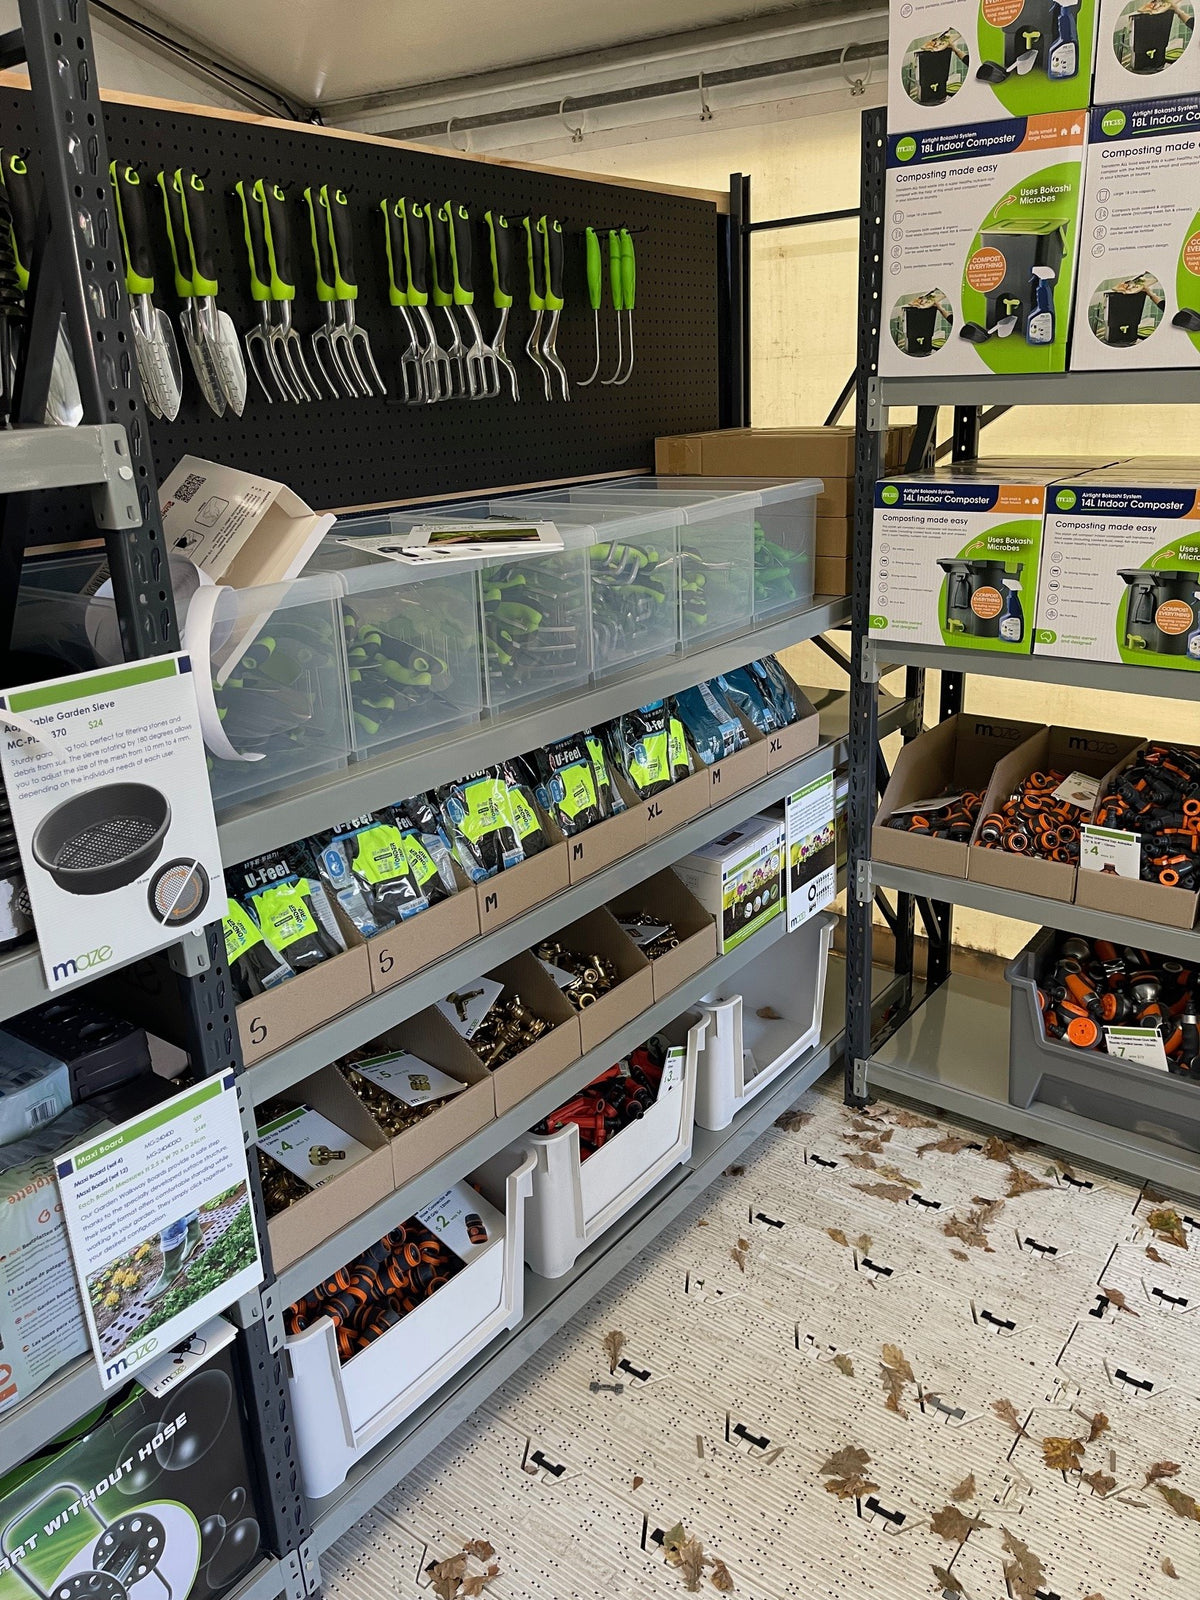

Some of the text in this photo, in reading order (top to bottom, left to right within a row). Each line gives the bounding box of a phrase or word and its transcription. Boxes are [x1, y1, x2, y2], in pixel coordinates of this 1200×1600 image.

[1132, 109, 1153, 117] Airtight
[1132, 118, 1147, 127] 18L
[1150, 115, 1182, 125] Indoor
[921, 134, 1016, 153] 18L Indoor Composter
[922, 132, 977, 144] Airtight Bokashi System
[1102, 141, 1195, 158] Composting made
[896, 164, 998, 182] Composting made easy
[1020, 184, 1071, 196] Uses Bokashi
[1020, 195, 1056, 204] Microbes
[969, 262, 1003, 270] EVERYTHING
[903, 494, 915, 502] 14L
[944, 497, 990, 505] Composter
[1081, 499, 1184, 510] 14L Indoor Composter
[882, 515, 925, 524] Composting
[1056, 521, 1157, 533] Composting made easy
[988, 536, 1004, 544] Uses
[1179, 545, 1198, 553] Uses
[56, 701, 114, 720] Garden Sieve
[88, 718, 103, 729] $24
[976, 723, 1021, 742] maze
[10, 753, 34, 766] Sturdy
[89, 733, 113, 745] perfect
[125, 725, 148, 735] filtering
[148, 720, 167, 729] stones
[168, 715, 181, 724] and
[770, 739, 782, 754] XL
[1069, 736, 1119, 755] maze
[13, 766, 36, 777] debris
[36, 762, 53, 770] from
[83, 750, 99, 758] sieve
[100, 742, 126, 753] rotating
[136, 735, 147, 743] 180
[148, 729, 173, 740] degrees
[174, 724, 192, 733] allows
[555, 746, 582, 766] U-Feel
[15, 780, 30, 790] you
[40, 770, 61, 781] adjust
[89, 760, 96, 768] of
[110, 752, 127, 761] mesh
[127, 748, 142, 756] from
[144, 744, 151, 752] 10
[18, 784, 58, 799] depending
[83, 766, 114, 780] individual
[115, 761, 135, 770] needs
[136, 757, 142, 765] of
[144, 754, 160, 763] each
[712, 769, 721, 784] M
[648, 802, 662, 820] XL
[390, 842, 400, 869] WONDER
[573, 843, 583, 860] M
[1090, 846, 1098, 855] 4
[244, 860, 291, 889] U-Feel
[485, 893, 498, 912] M
[289, 905, 304, 931] WONDER
[227, 919, 246, 945] WONDER
[53, 945, 113, 981] maze
[379, 949, 394, 973] S
[250, 1017, 267, 1044] S
[1118, 1047, 1125, 1057] 7
[668, 1071, 672, 1081] 3
[77, 1136, 123, 1165] Maxi Board
[281, 1141, 293, 1152] 4
[73, 1160, 116, 1187] Maxi Board (set
[76, 1166, 128, 1199] Maxi Board (set 12)
[80, 1146, 207, 1221] Our Garden Walkway Boards provide safe
[82, 1170, 181, 1231] thanks the specially developed
[84, 1230, 98, 1241] their
[99, 1221, 116, 1232] large
[116, 1207, 137, 1222] format
[155, 1177, 190, 1200] comfortable
[190, 1162, 214, 1179] standing
[436, 1215, 450, 1228] 2
[86, 1235, 111, 1251] working
[118, 1222, 132, 1233] your
[103, 1236, 126, 1253] desired
[127, 1213, 166, 1238] configuration
[106, 1337, 158, 1380] maze
[161, 1364, 187, 1385] maze
[43, 1456, 136, 1537] WITHOUT
[138, 1412, 188, 1462] HOSE
